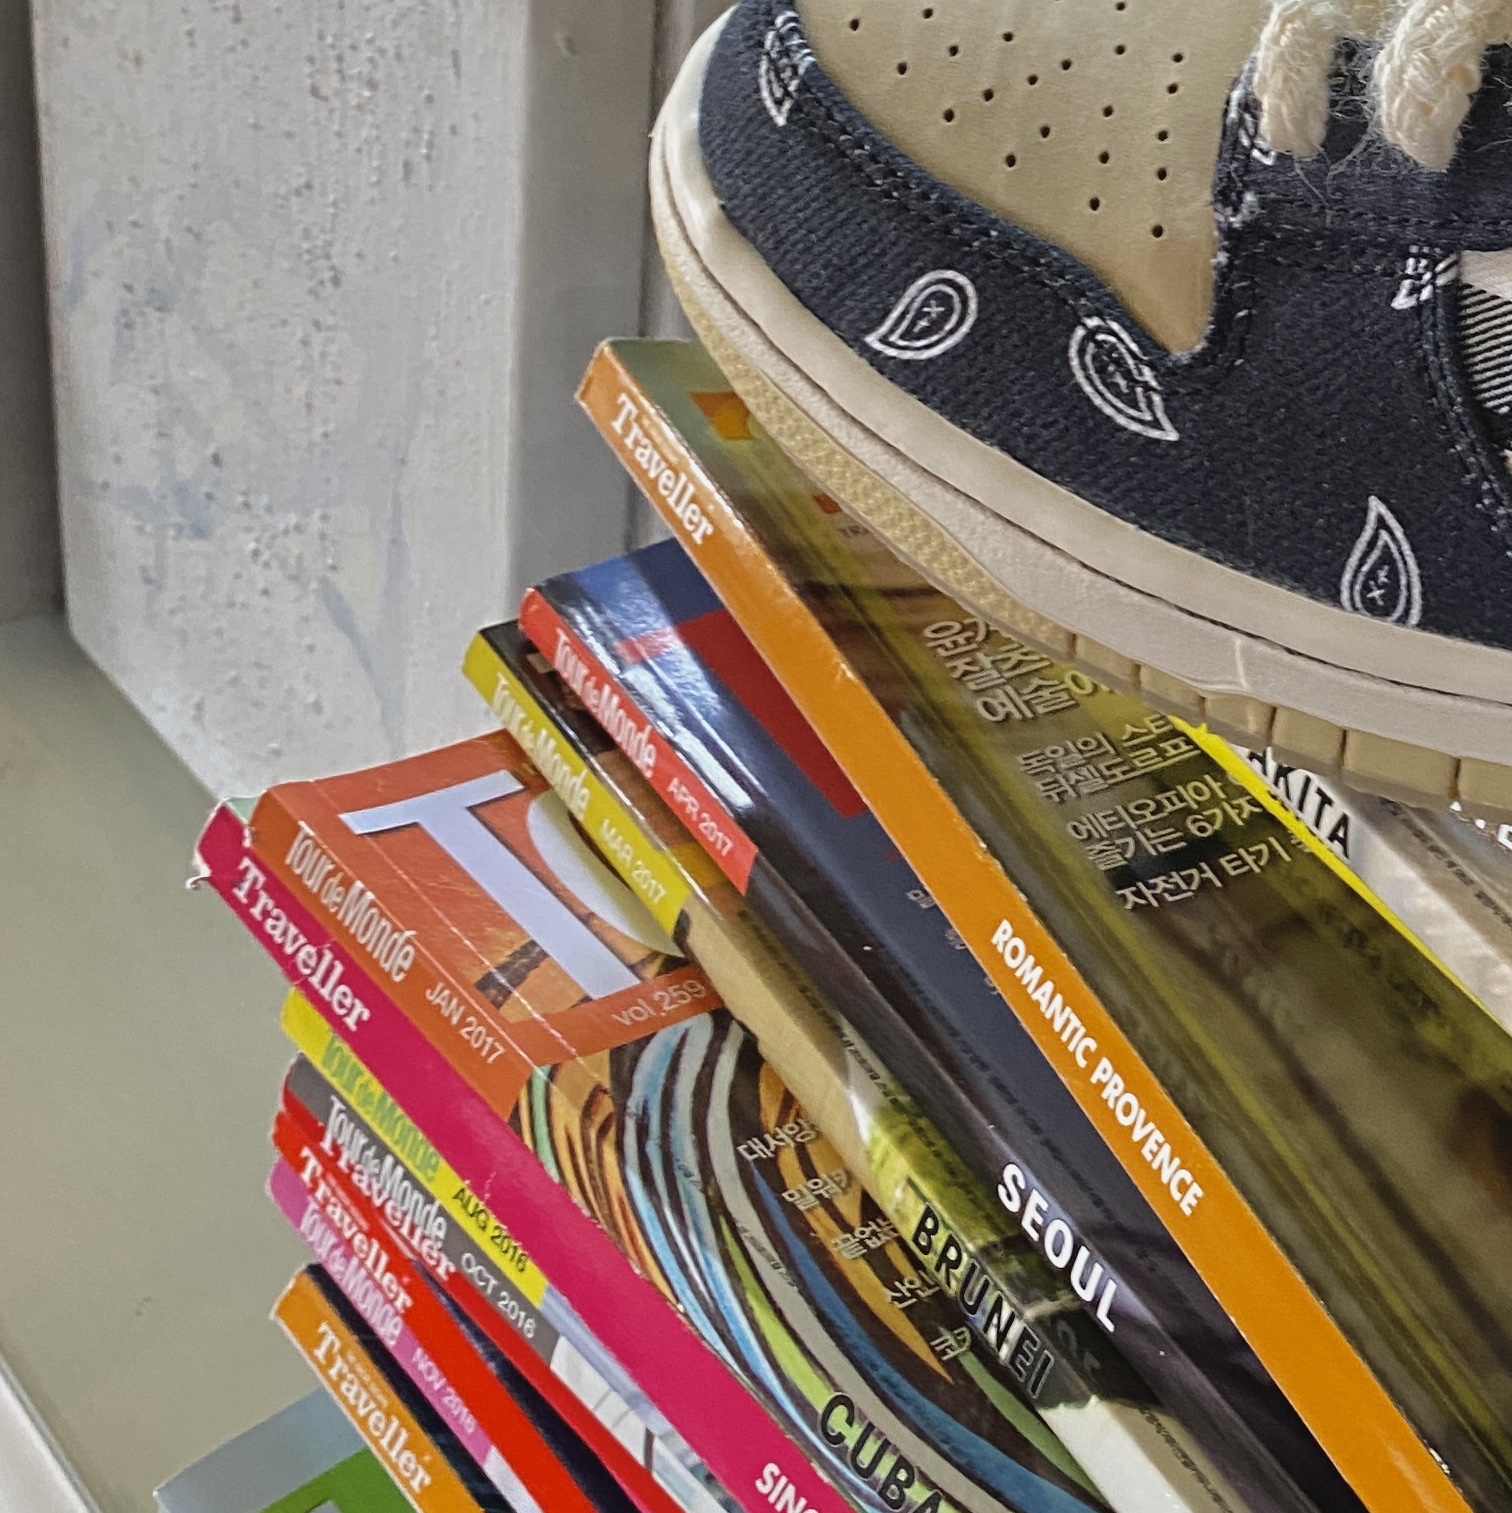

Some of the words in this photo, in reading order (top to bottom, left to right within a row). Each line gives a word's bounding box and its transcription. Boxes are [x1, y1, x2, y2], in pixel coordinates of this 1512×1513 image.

[611, 392, 715, 545] Traveller
[667, 777, 699, 822] APR
[697, 811, 735, 857] 2017
[1066, 774, 1226, 845] 에티오피아
[1085, 821, 1185, 873] 즐기는
[600, 817, 635, 868] MAR
[630, 859, 668, 904] 2017
[1114, 866, 1221, 913] 자전거
[1220, 835, 1293, 877] 타기
[230, 857, 372, 1033] Traveller
[423, 981, 477, 1028] JAN
[450, 1017, 506, 1064] 2017
[991, 919, 1098, 1069] ROMANTIC
[1090, 1057, 1205, 1218] PROVENCE
[299, 1146, 414, 1313] Traveller
[452, 1187, 493, 1243] AUG
[490, 1223, 529, 1274] 2016
[997, 1161, 1118, 1334] SEOUL
[460, 1251, 500, 1300] OCT
[494, 1293, 536, 1340] 2016
[911, 1201, 1055, 1398] BRUNEI
[315, 1323, 433, 1494] Traveller
[411, 1347, 449, 1398] NOV
